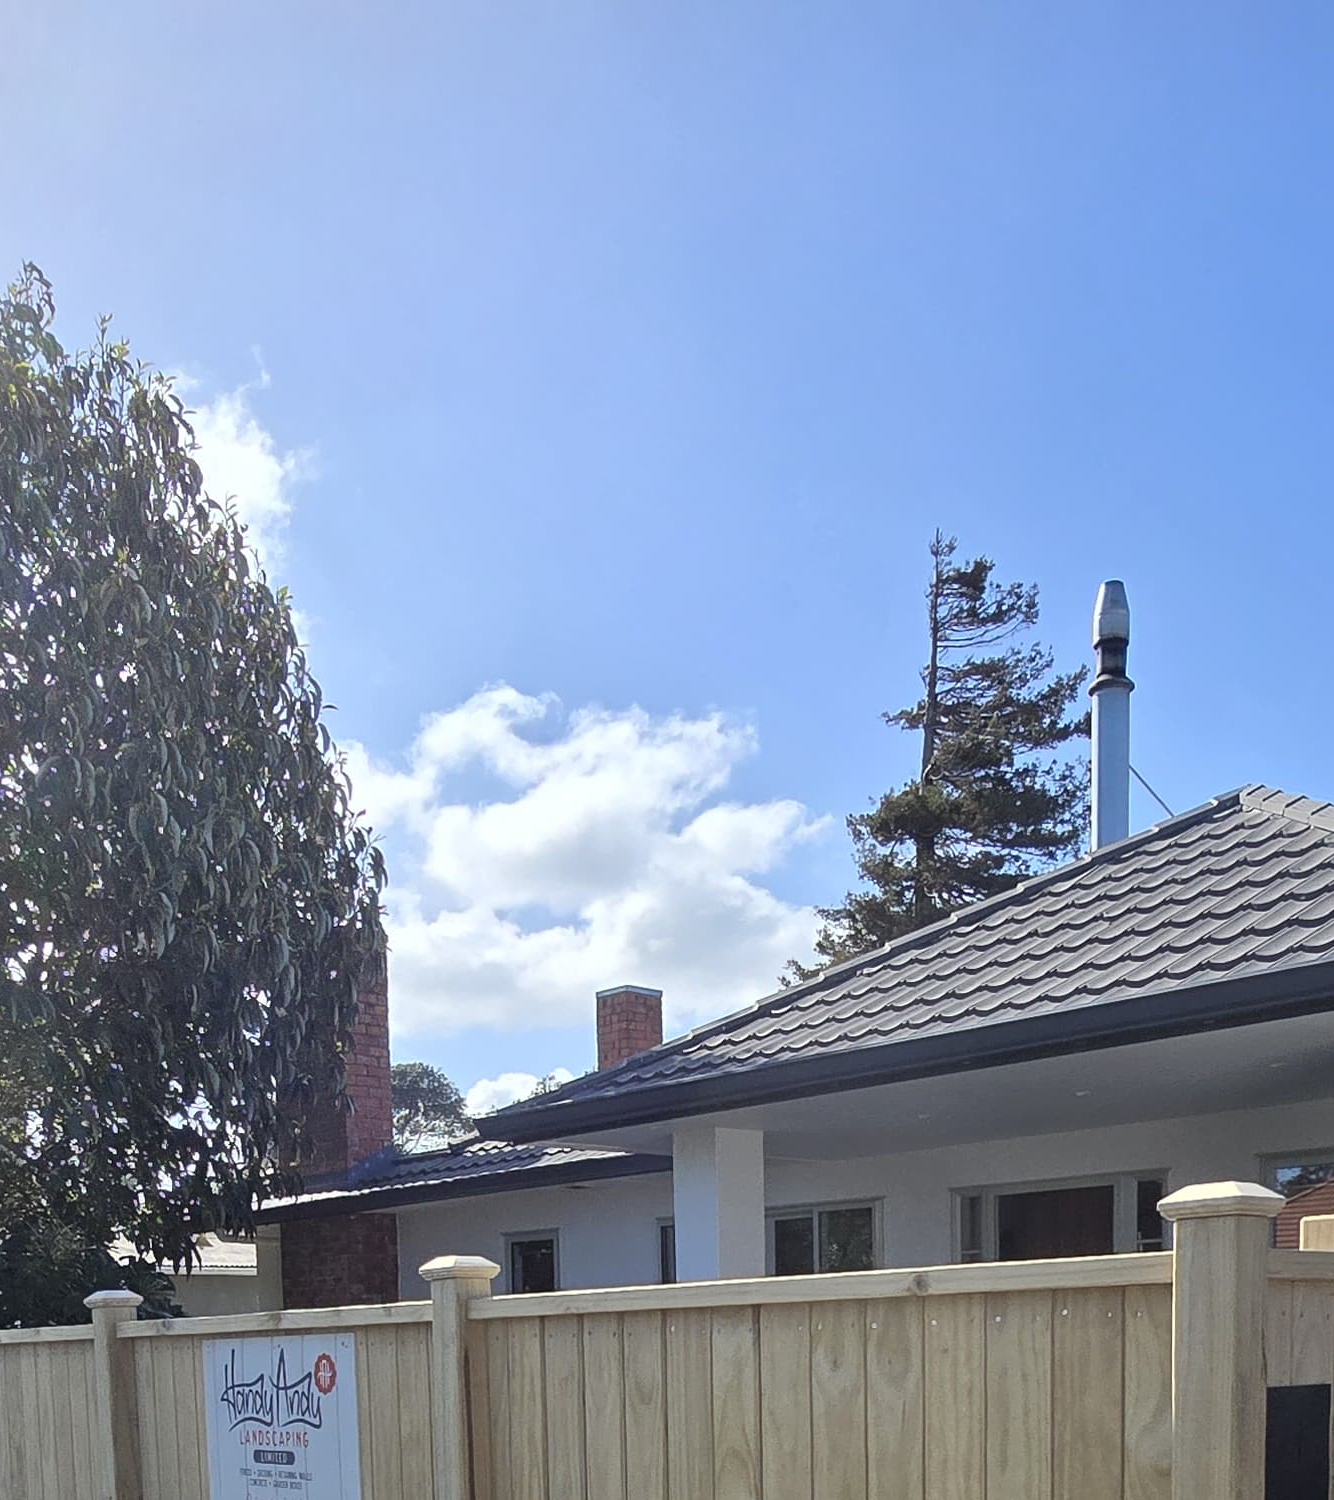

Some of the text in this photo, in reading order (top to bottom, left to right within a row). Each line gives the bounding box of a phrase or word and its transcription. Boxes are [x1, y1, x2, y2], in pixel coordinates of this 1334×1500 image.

[220, 1347, 323, 1432] Handy Andy
[239, 1430, 310, 1448] LANDSCAPING
[260, 1451, 289, 1464] LIMITED
